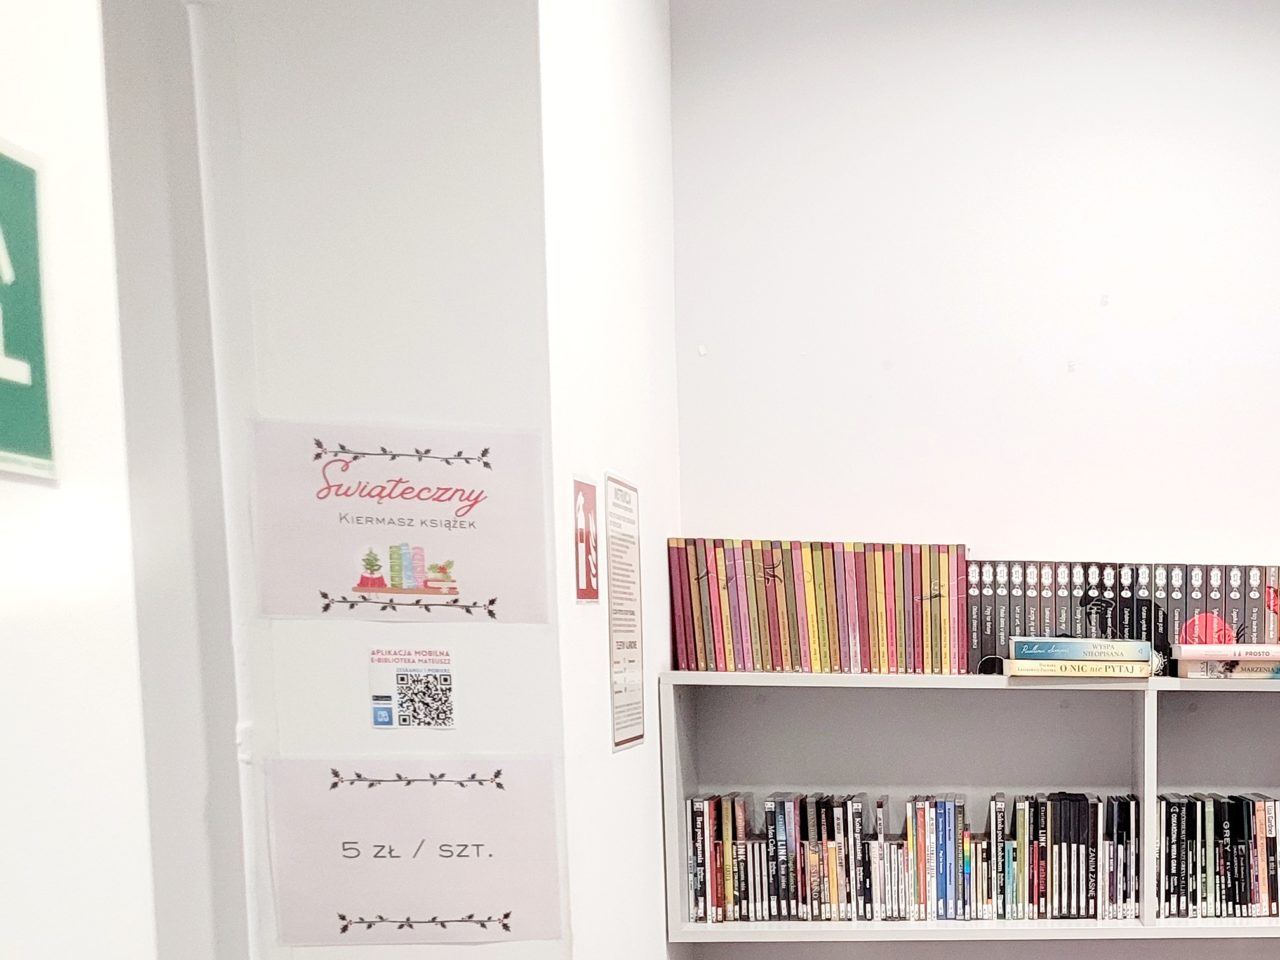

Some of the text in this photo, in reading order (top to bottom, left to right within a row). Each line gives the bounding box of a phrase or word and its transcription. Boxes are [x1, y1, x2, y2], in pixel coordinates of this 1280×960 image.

[1070, 664, 1087, 673] NIC
[1104, 665, 1134, 674] PYTAJ
[1223, 821, 1231, 852] GREY
[341, 841, 361, 859] 5
[372, 843, 401, 859] ZŁ
[438, 842, 494, 859] SZT.
[738, 841, 746, 861] LINK
[778, 841, 786, 861] LINK
